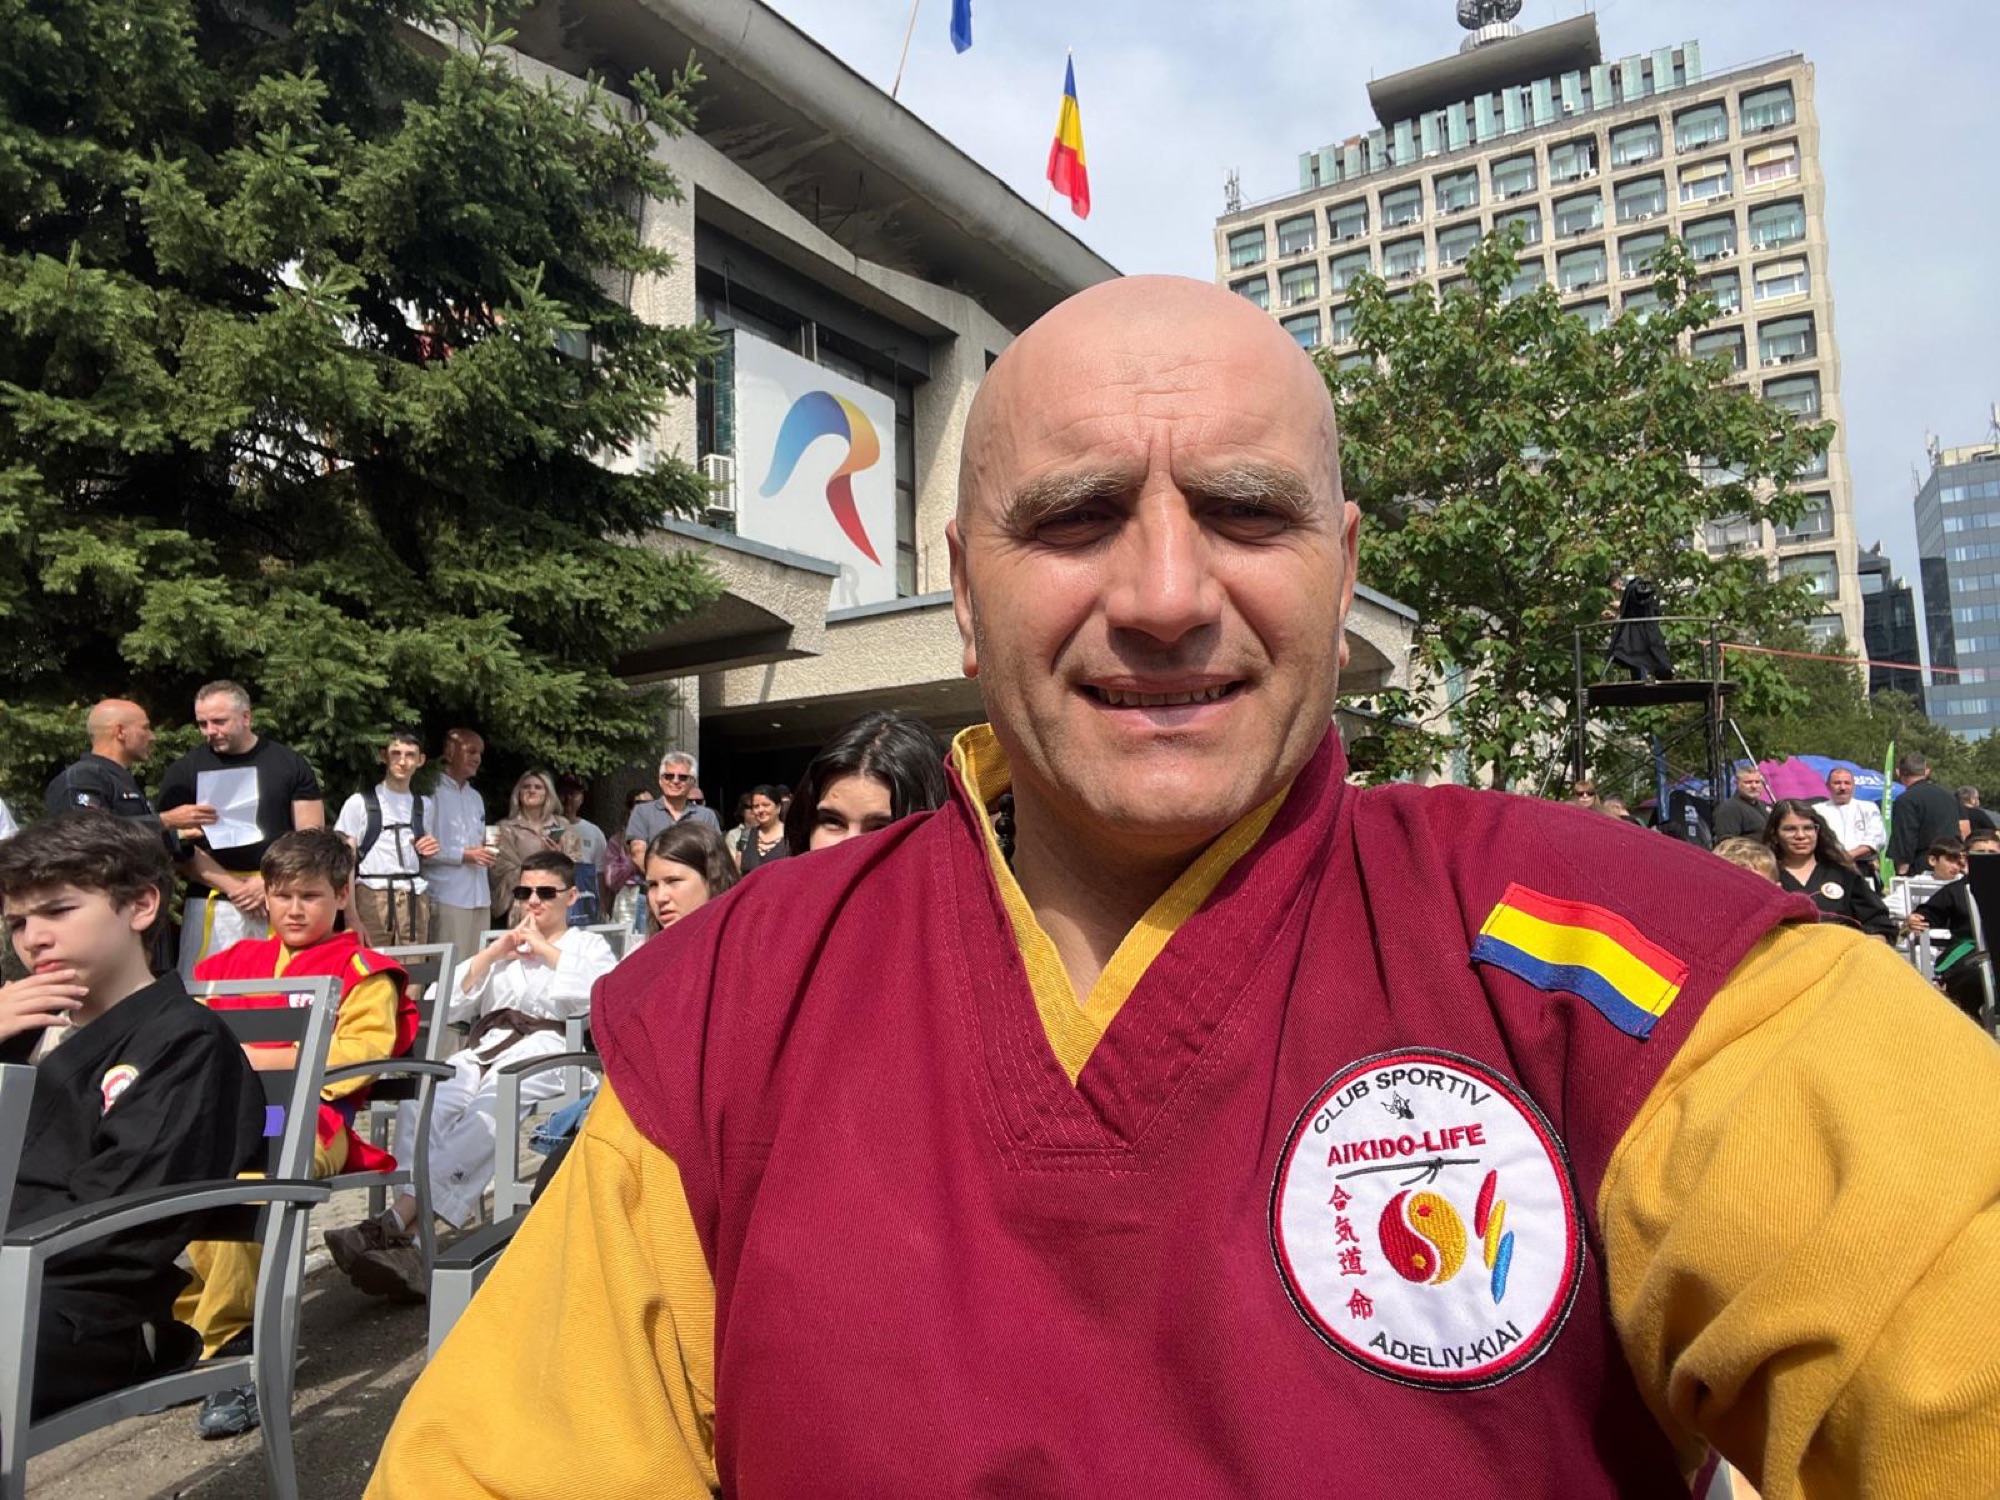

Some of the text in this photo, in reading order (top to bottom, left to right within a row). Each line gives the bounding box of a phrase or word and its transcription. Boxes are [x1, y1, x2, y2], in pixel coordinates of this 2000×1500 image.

[1314, 1068, 1491, 1134] CLUB SPORTIV
[1327, 1123, 1486, 1168] AIKIDO-LIFE
[1369, 1320, 1523, 1369] ADELIV-KIAI
